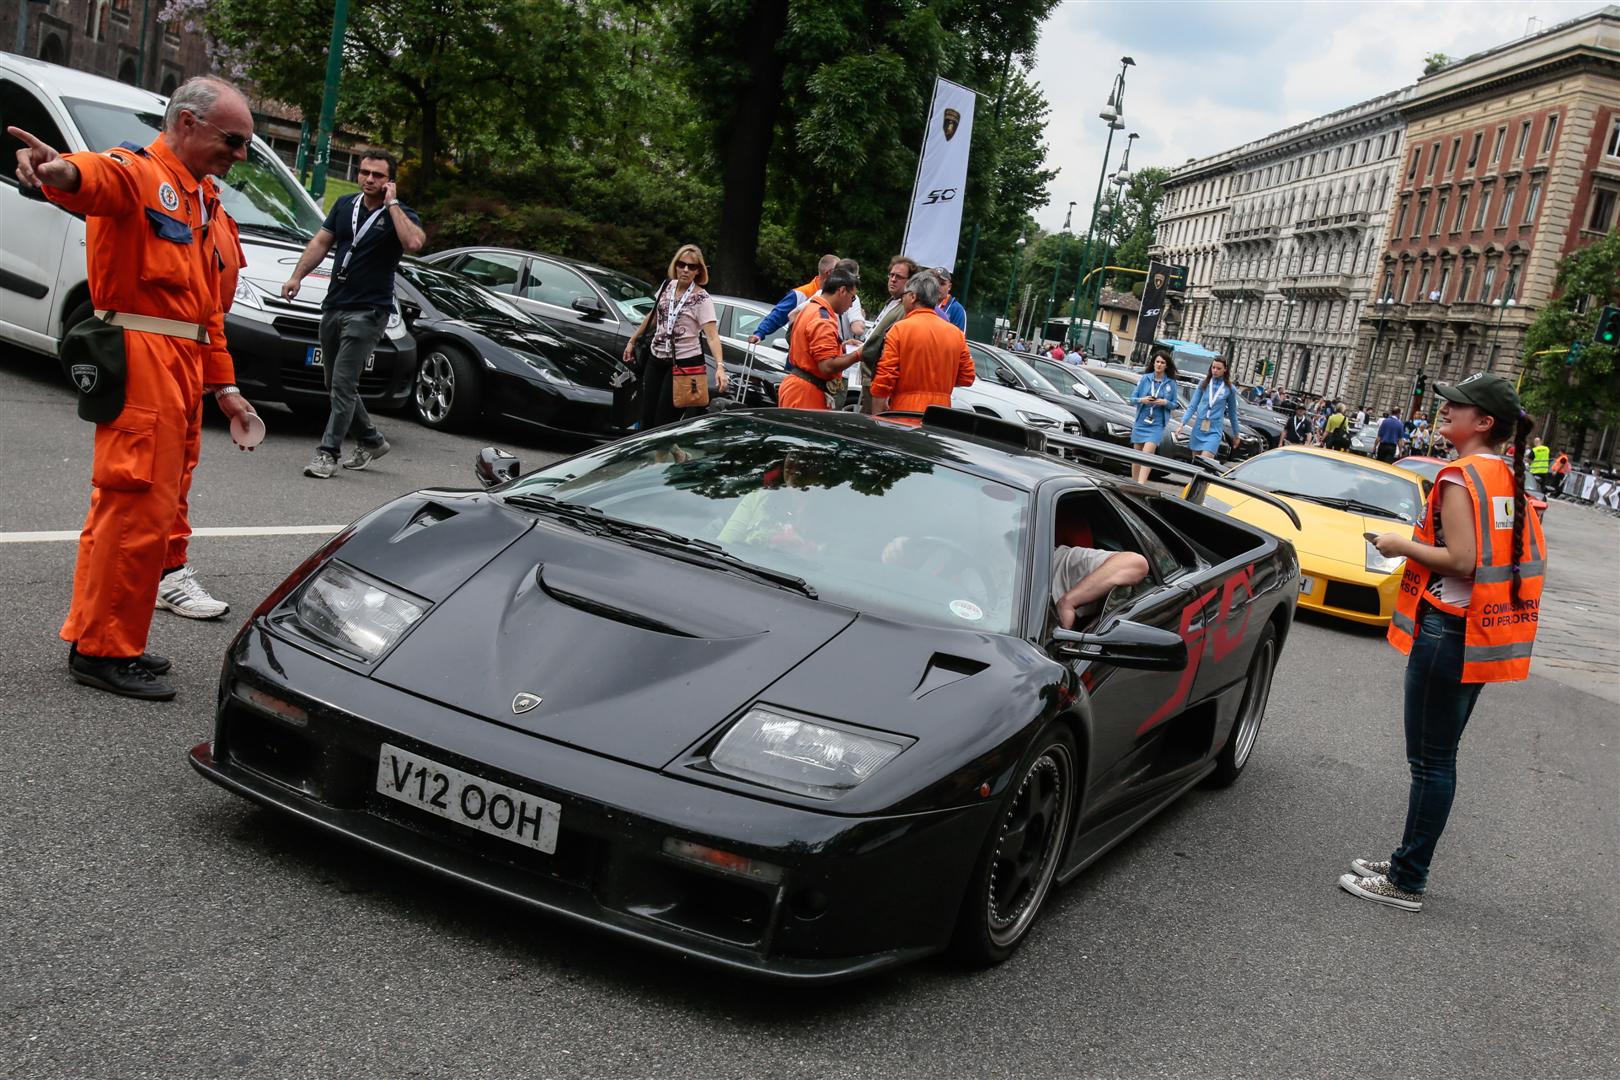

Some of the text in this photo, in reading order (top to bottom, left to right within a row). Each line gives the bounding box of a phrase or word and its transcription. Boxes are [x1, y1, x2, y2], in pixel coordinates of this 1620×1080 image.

[1482, 612, 1538, 627] DI PERORS
[391, 755, 542, 841] V12 OOH
